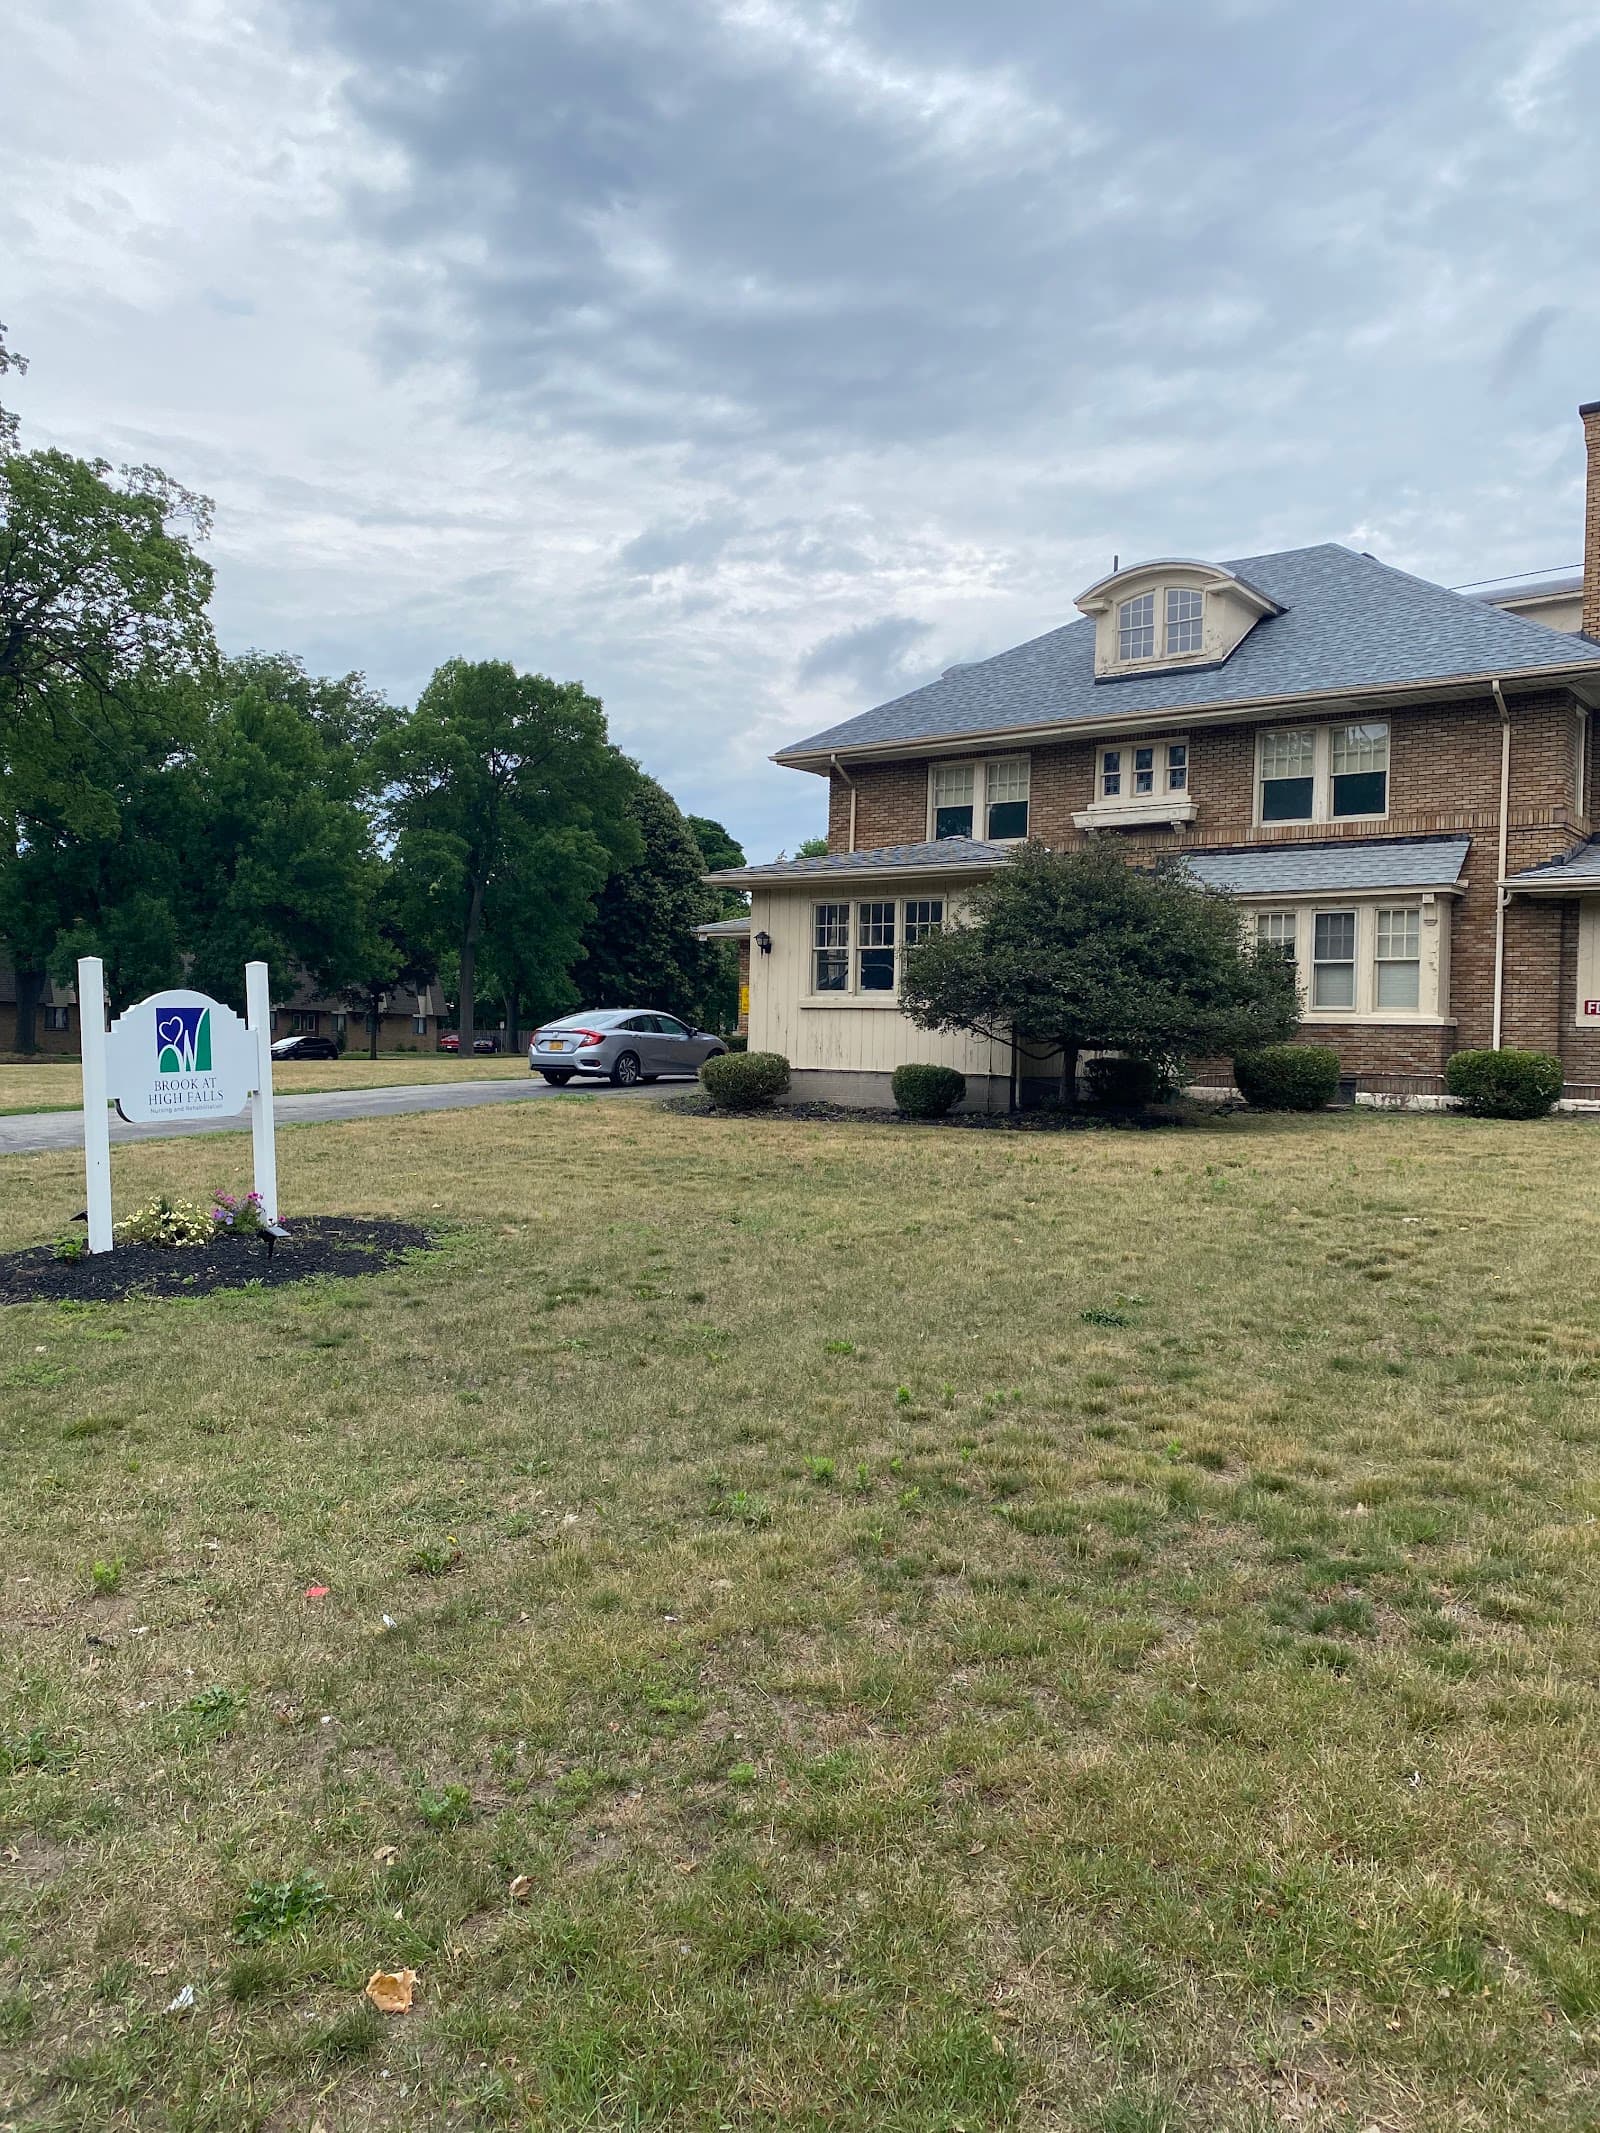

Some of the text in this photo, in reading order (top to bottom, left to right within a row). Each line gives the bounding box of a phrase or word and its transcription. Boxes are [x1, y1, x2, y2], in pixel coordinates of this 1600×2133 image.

[154, 1077, 217, 1091] BROOK AT
[149, 1089, 224, 1105] HIGH FALLS
[150, 1106, 173, 1114] Nursing
